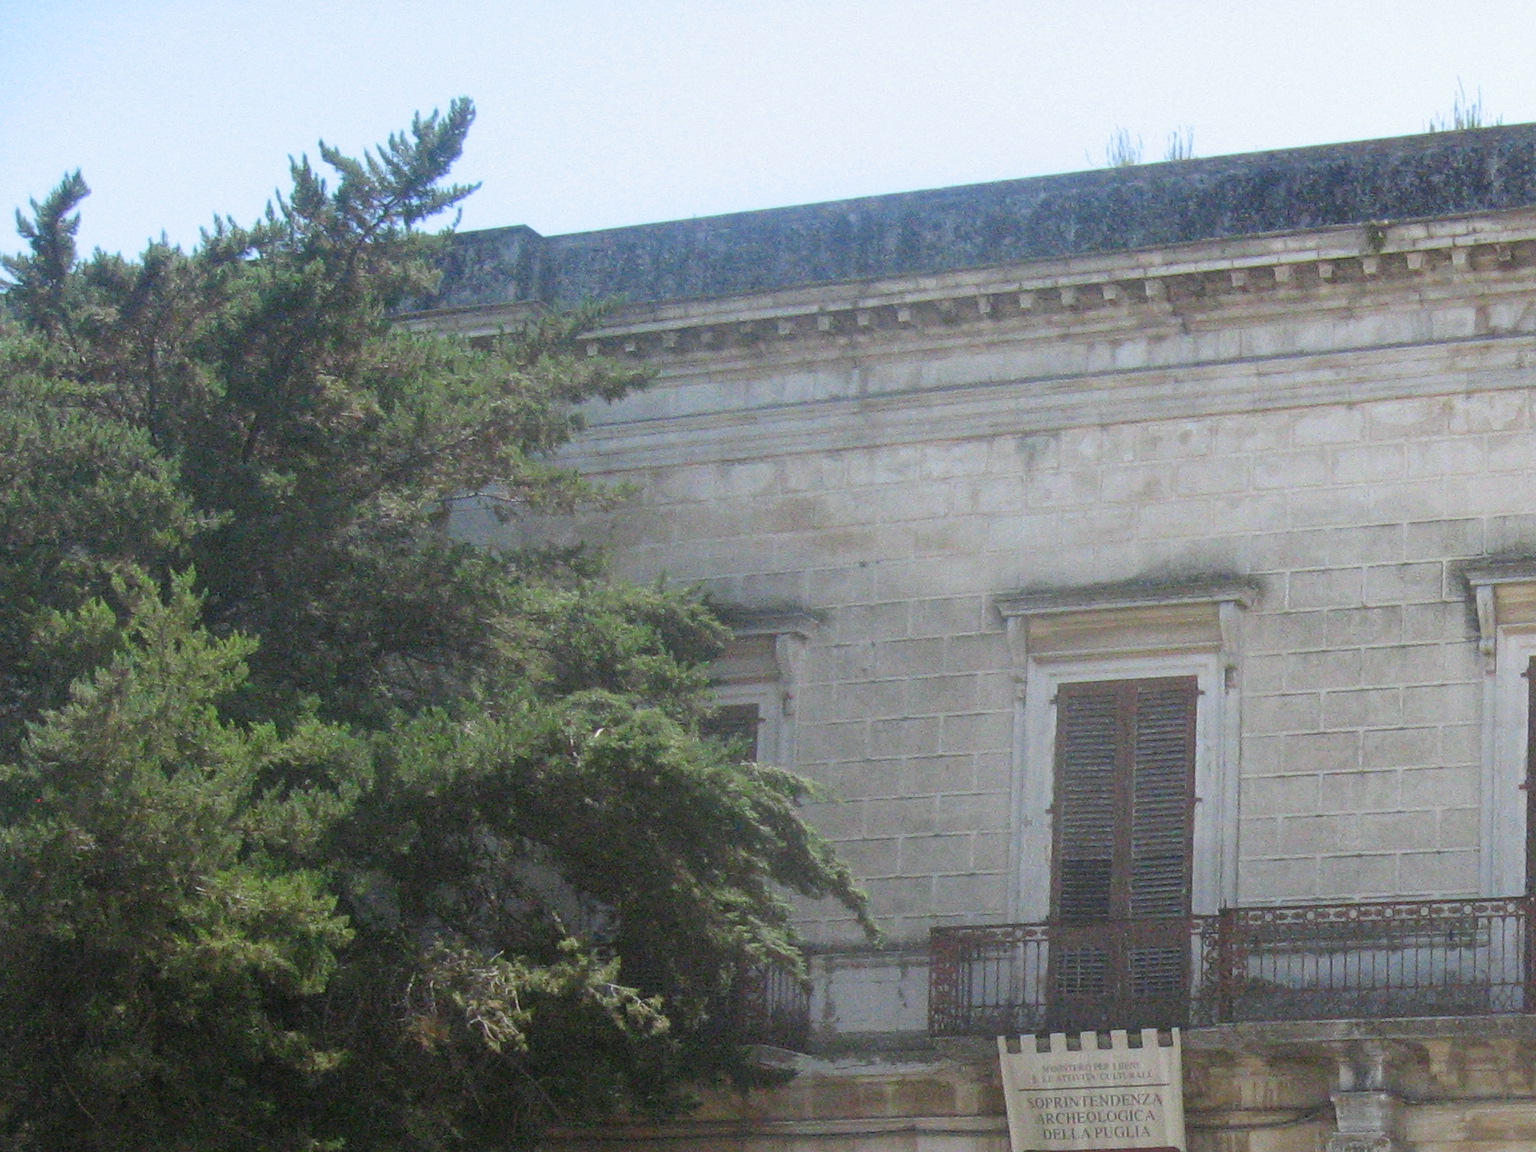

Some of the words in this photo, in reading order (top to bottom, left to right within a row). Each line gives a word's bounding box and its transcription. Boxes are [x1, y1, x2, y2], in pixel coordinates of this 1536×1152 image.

[1027, 1093, 1163, 1110] SOPRINTENDENZA
[1037, 1109, 1156, 1125] ARCHEOLOGICA
[1043, 1127, 1091, 1141] DELLA
[1094, 1125, 1151, 1139] PUGLIA
